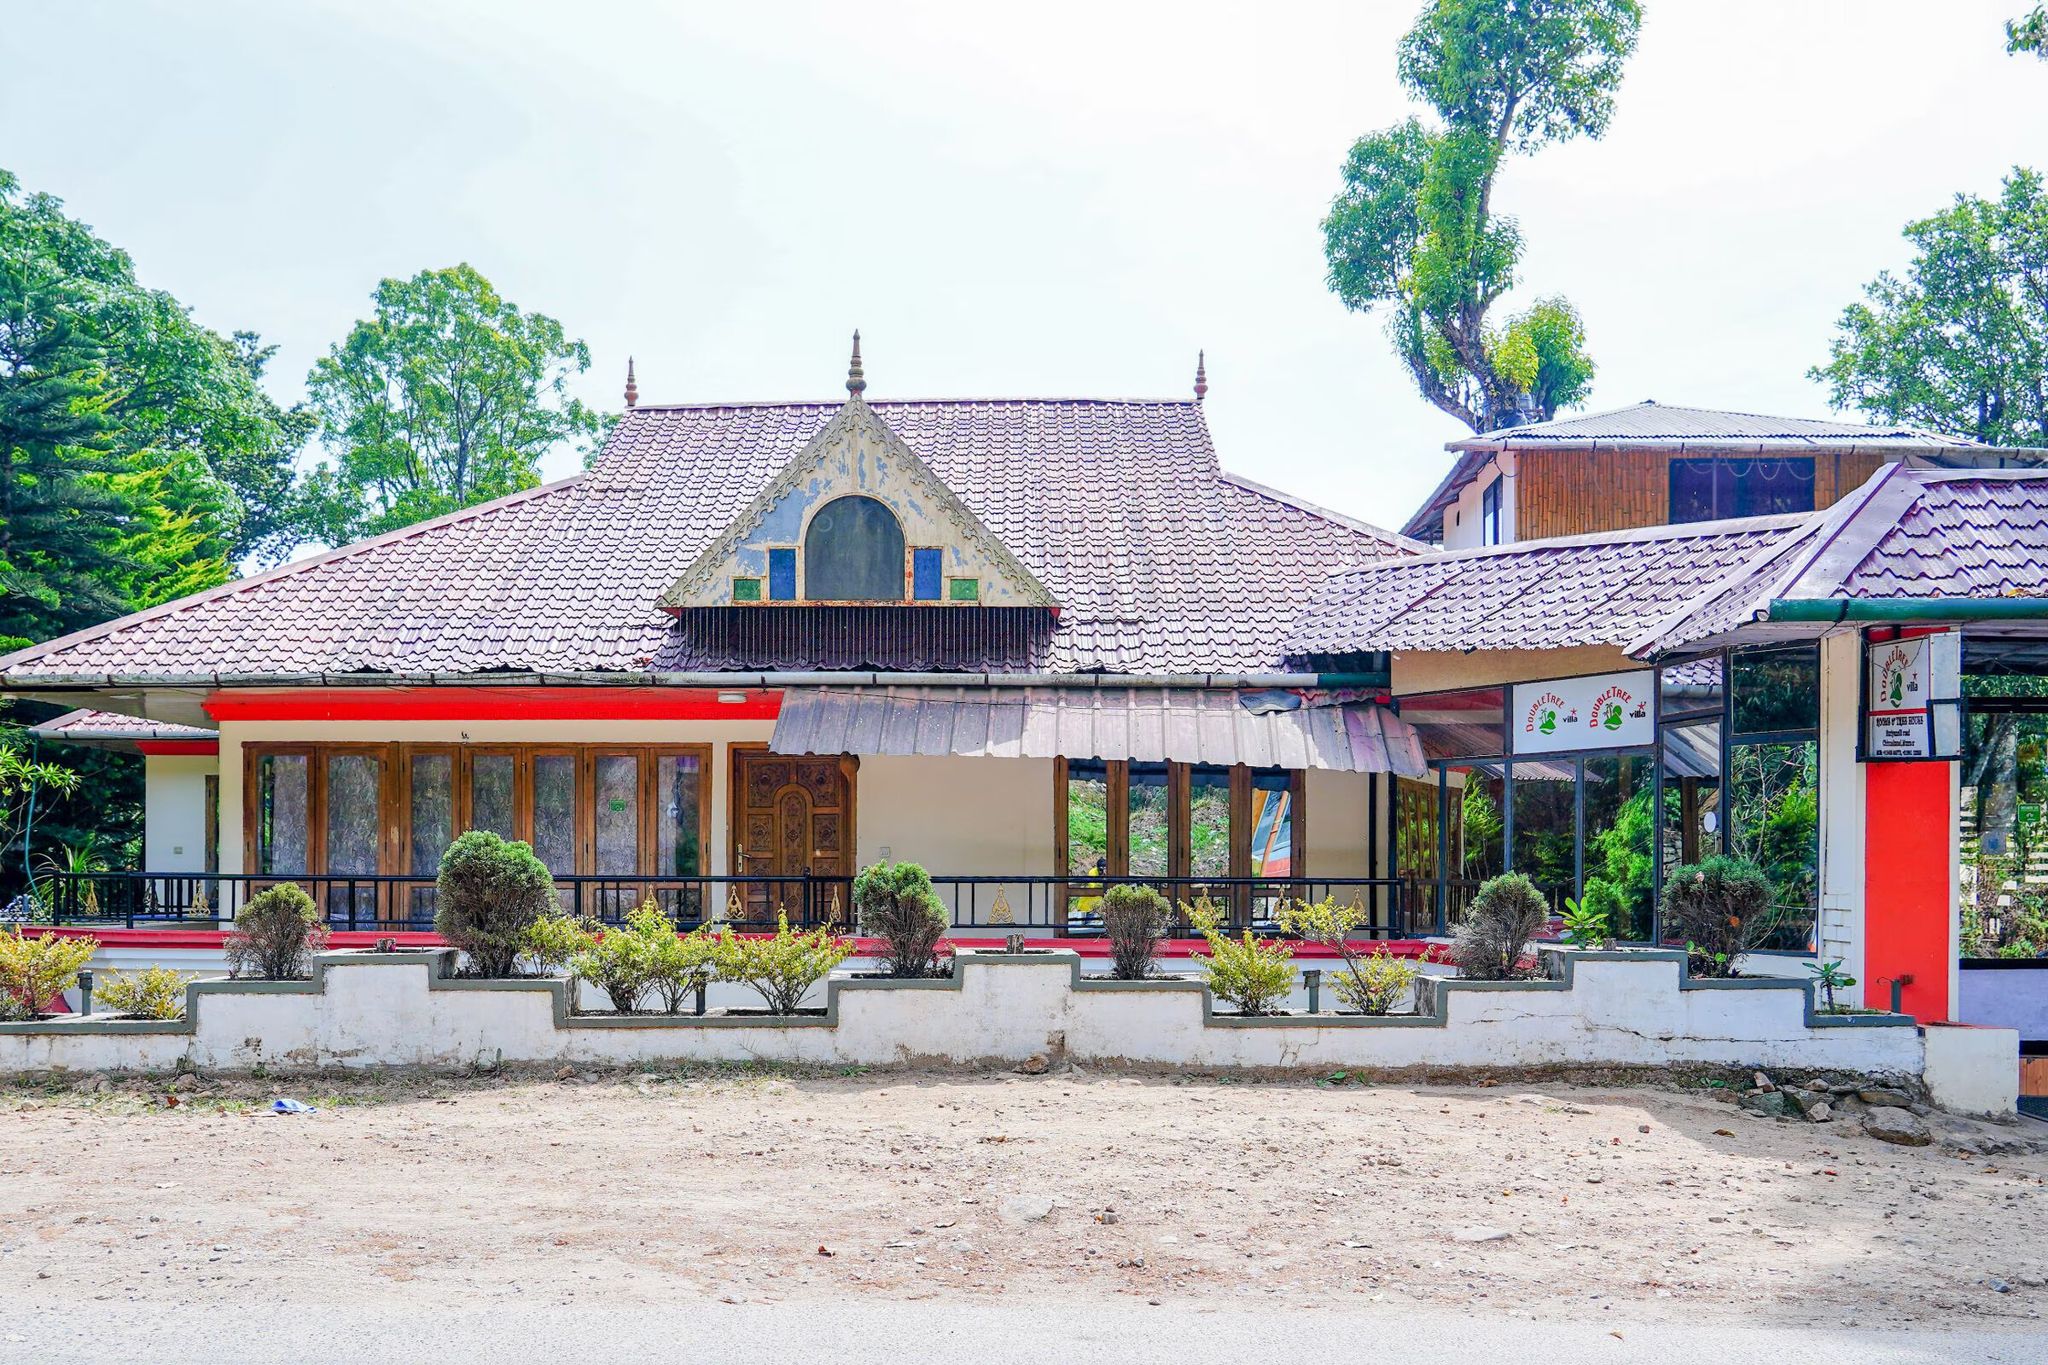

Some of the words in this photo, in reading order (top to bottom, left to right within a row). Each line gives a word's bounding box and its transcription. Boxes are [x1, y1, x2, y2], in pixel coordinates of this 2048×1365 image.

[1906, 681, 1919, 692] villa
[1562, 715, 1578, 723] villa
[1629, 709, 1646, 719] villa
